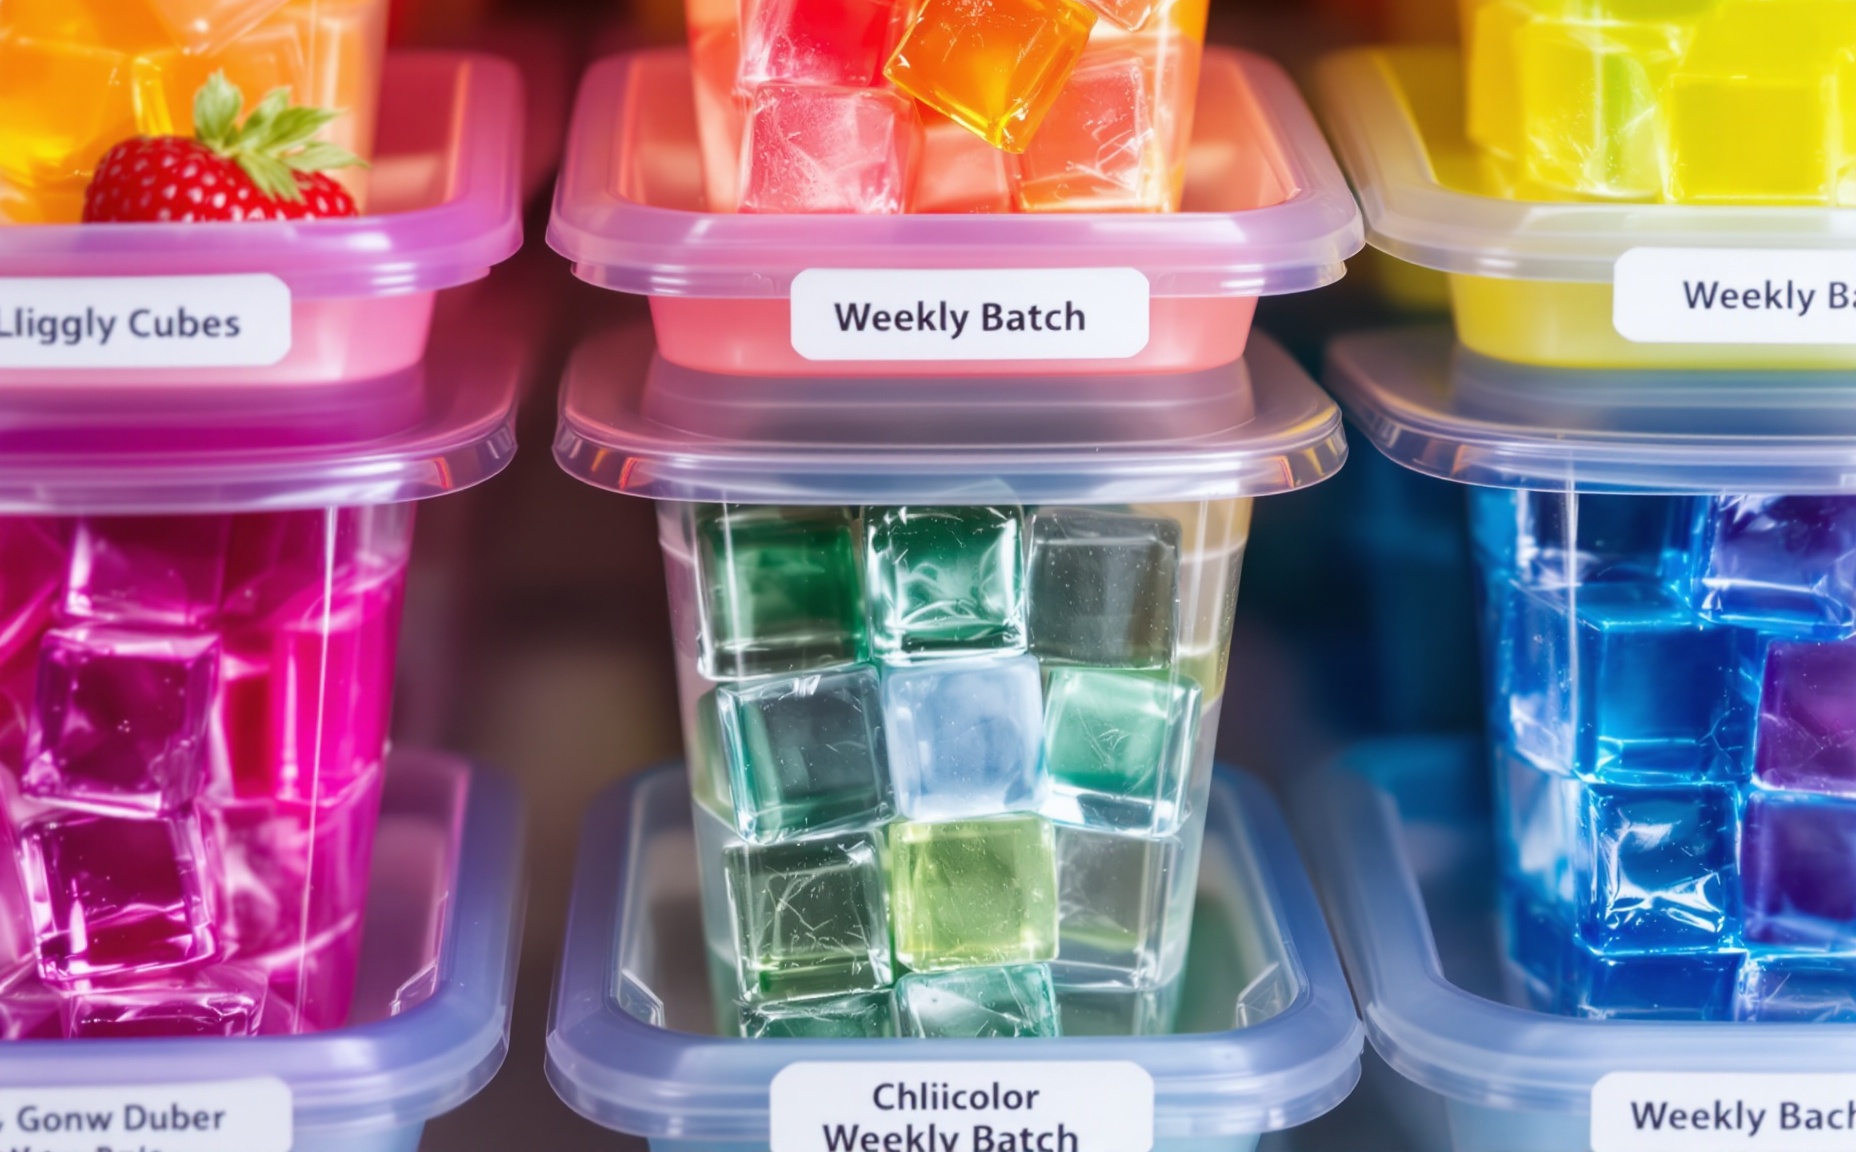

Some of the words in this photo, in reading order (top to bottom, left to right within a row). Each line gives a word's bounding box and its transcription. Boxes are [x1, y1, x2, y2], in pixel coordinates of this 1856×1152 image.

[1683, 280, 1816, 316] Weekly
[128, 308, 241, 338] Cubes
[834, 300, 970, 340] Weekly
[982, 300, 1086, 332] Batch
[872, 1081, 1040, 1111] Chliicolor
[16, 1105, 113, 1132] Gonw
[124, 1103, 226, 1132] Duber
[1630, 1099, 1766, 1137] Weekly
[822, 1124, 959, 1152] Weekly
[973, 1123, 1079, 1152] Batch
